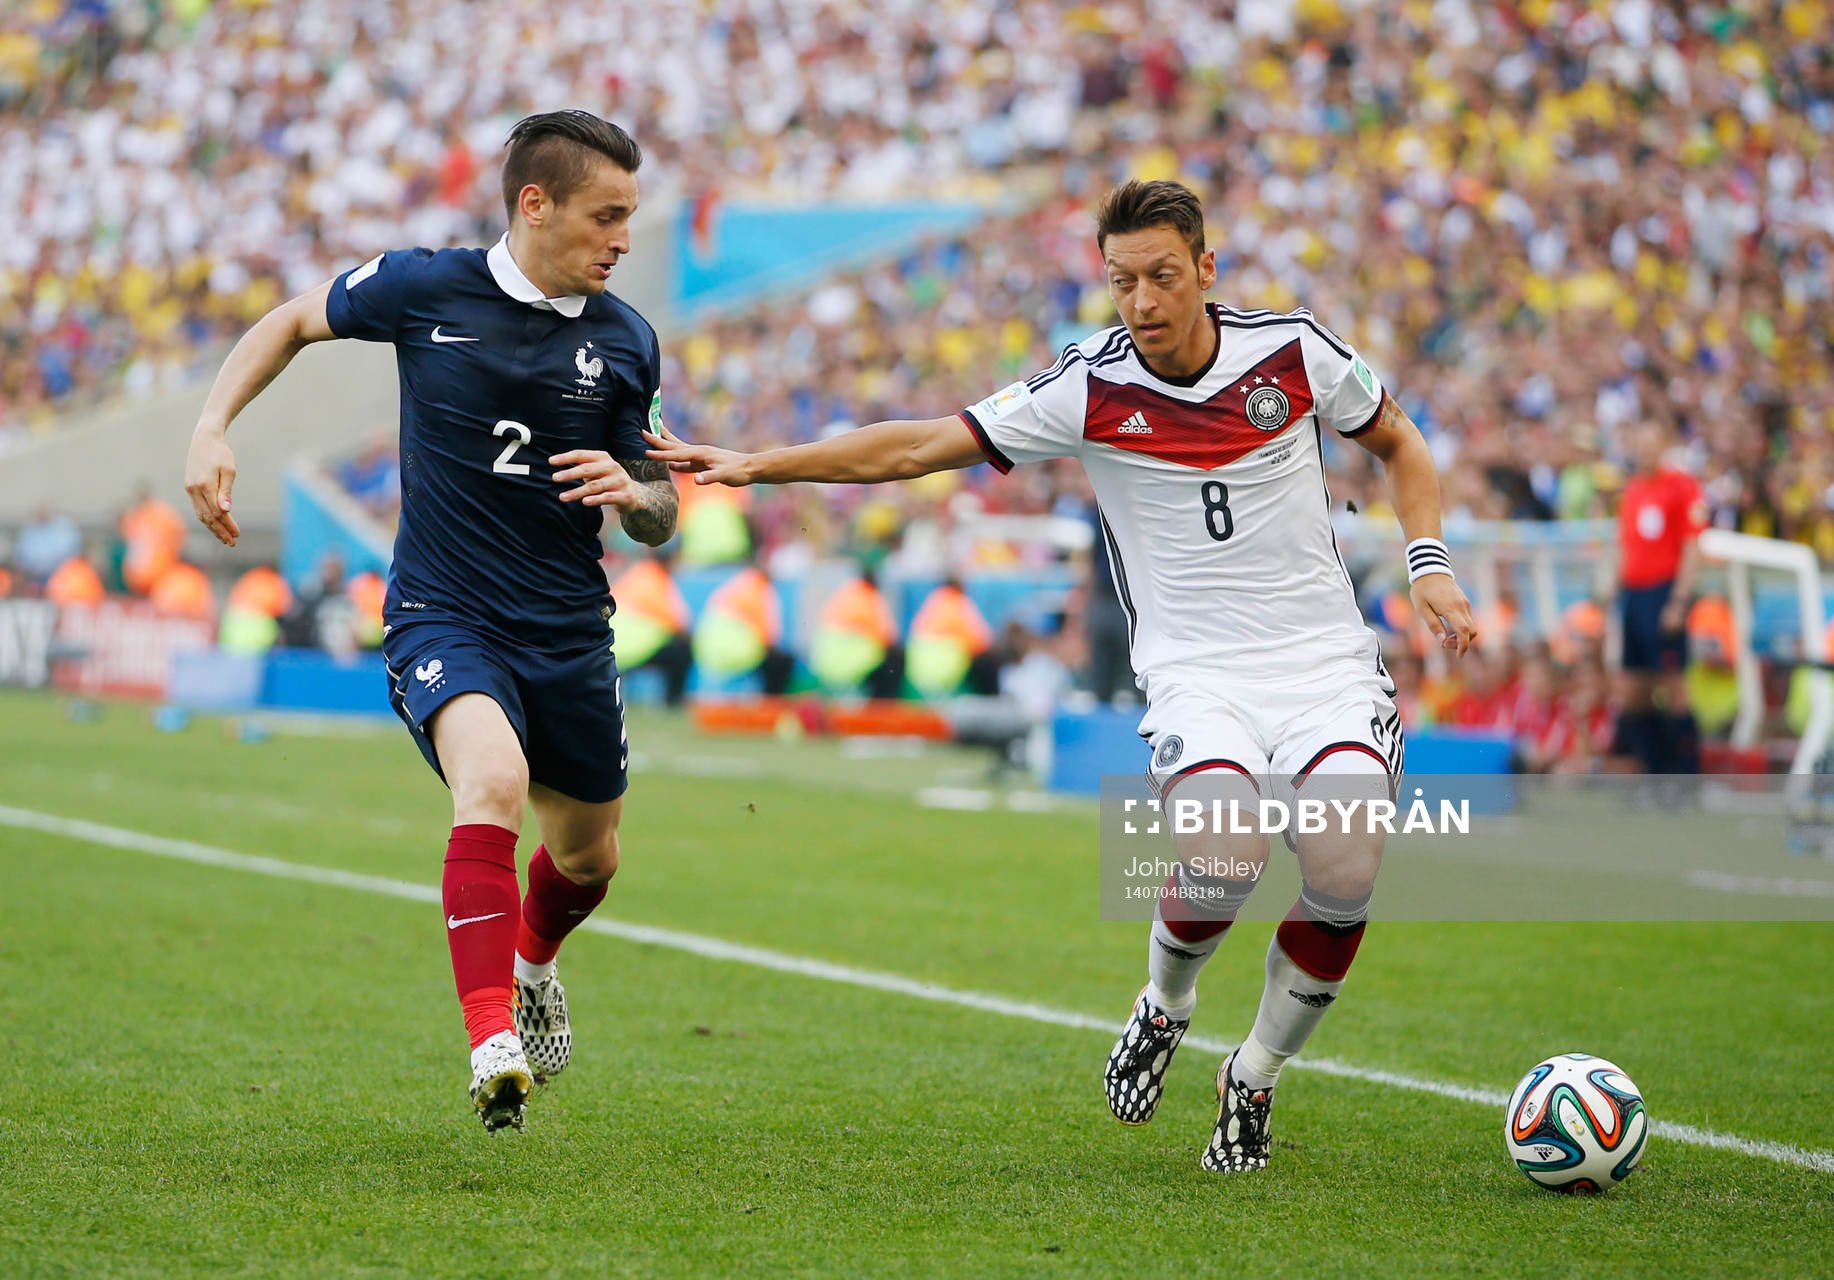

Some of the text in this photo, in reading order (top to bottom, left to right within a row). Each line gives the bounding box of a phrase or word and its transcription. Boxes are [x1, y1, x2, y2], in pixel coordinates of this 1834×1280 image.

[492, 419, 532, 476] 2
[1117, 424, 1153, 434] adidas
[1200, 480, 1234, 541] 8
